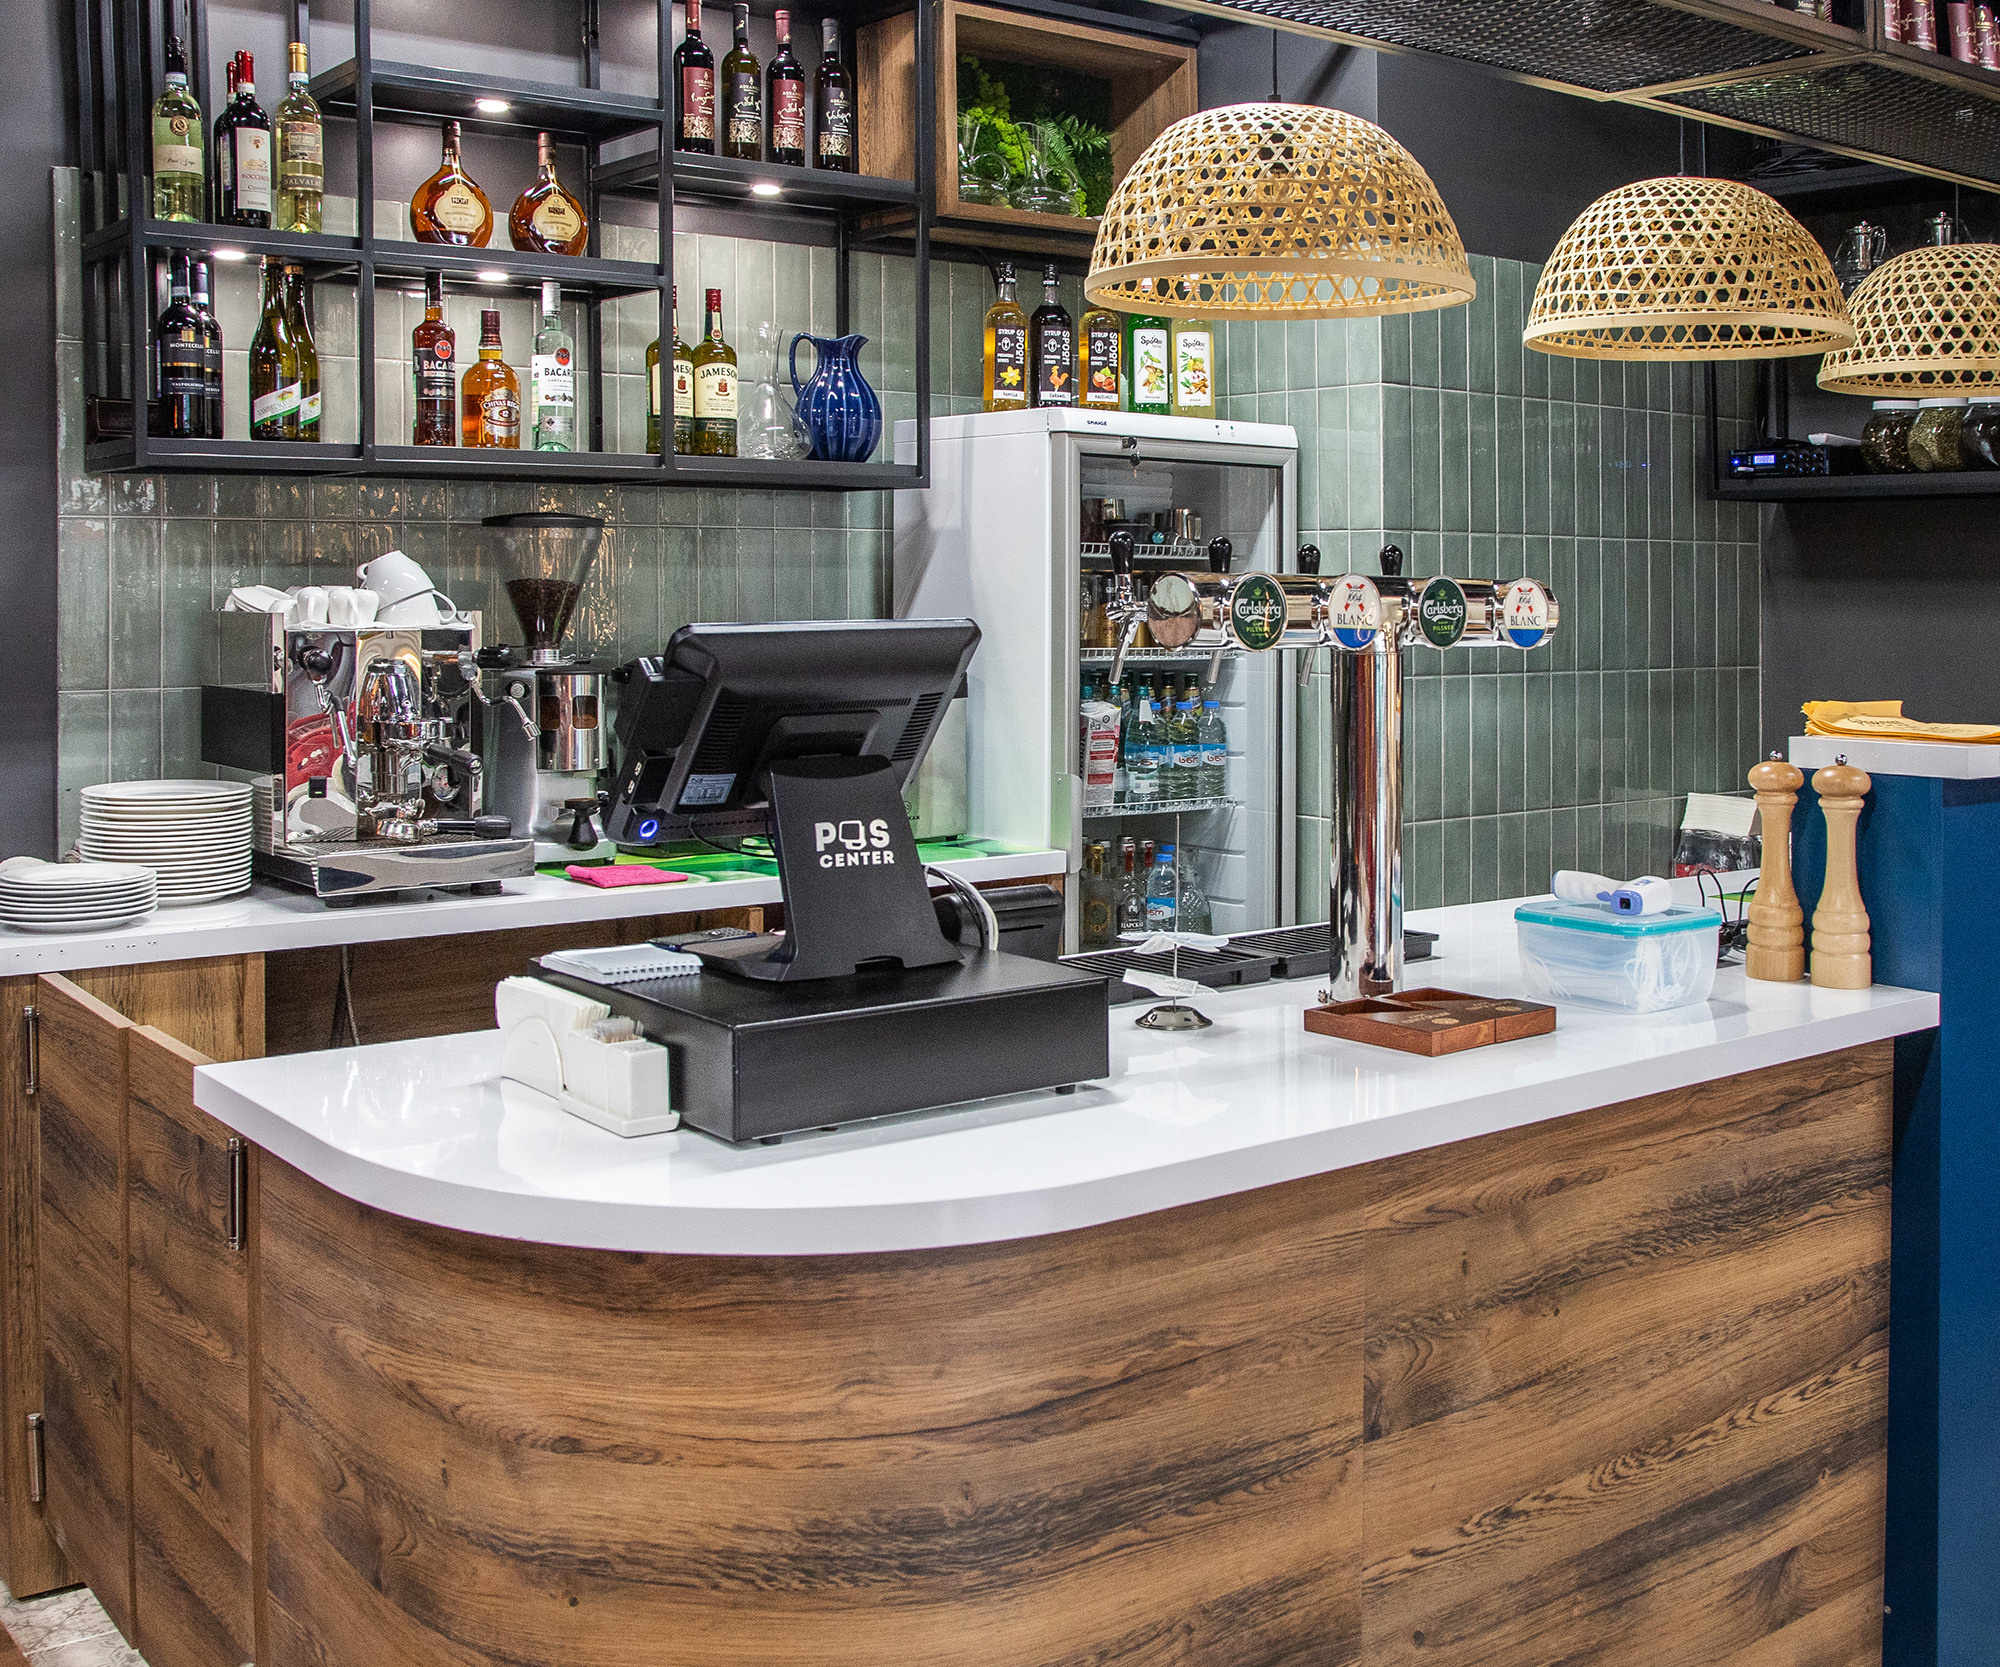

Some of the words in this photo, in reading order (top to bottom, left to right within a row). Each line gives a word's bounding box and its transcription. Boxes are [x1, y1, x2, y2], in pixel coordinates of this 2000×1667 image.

[1235, 598, 1282, 619] Carlsberg
[1423, 599, 1464, 618] Carlsberg
[1337, 613, 1373, 625] BLANC
[1510, 616, 1541, 626] BLANC
[819, 850, 895, 868] CENTER
